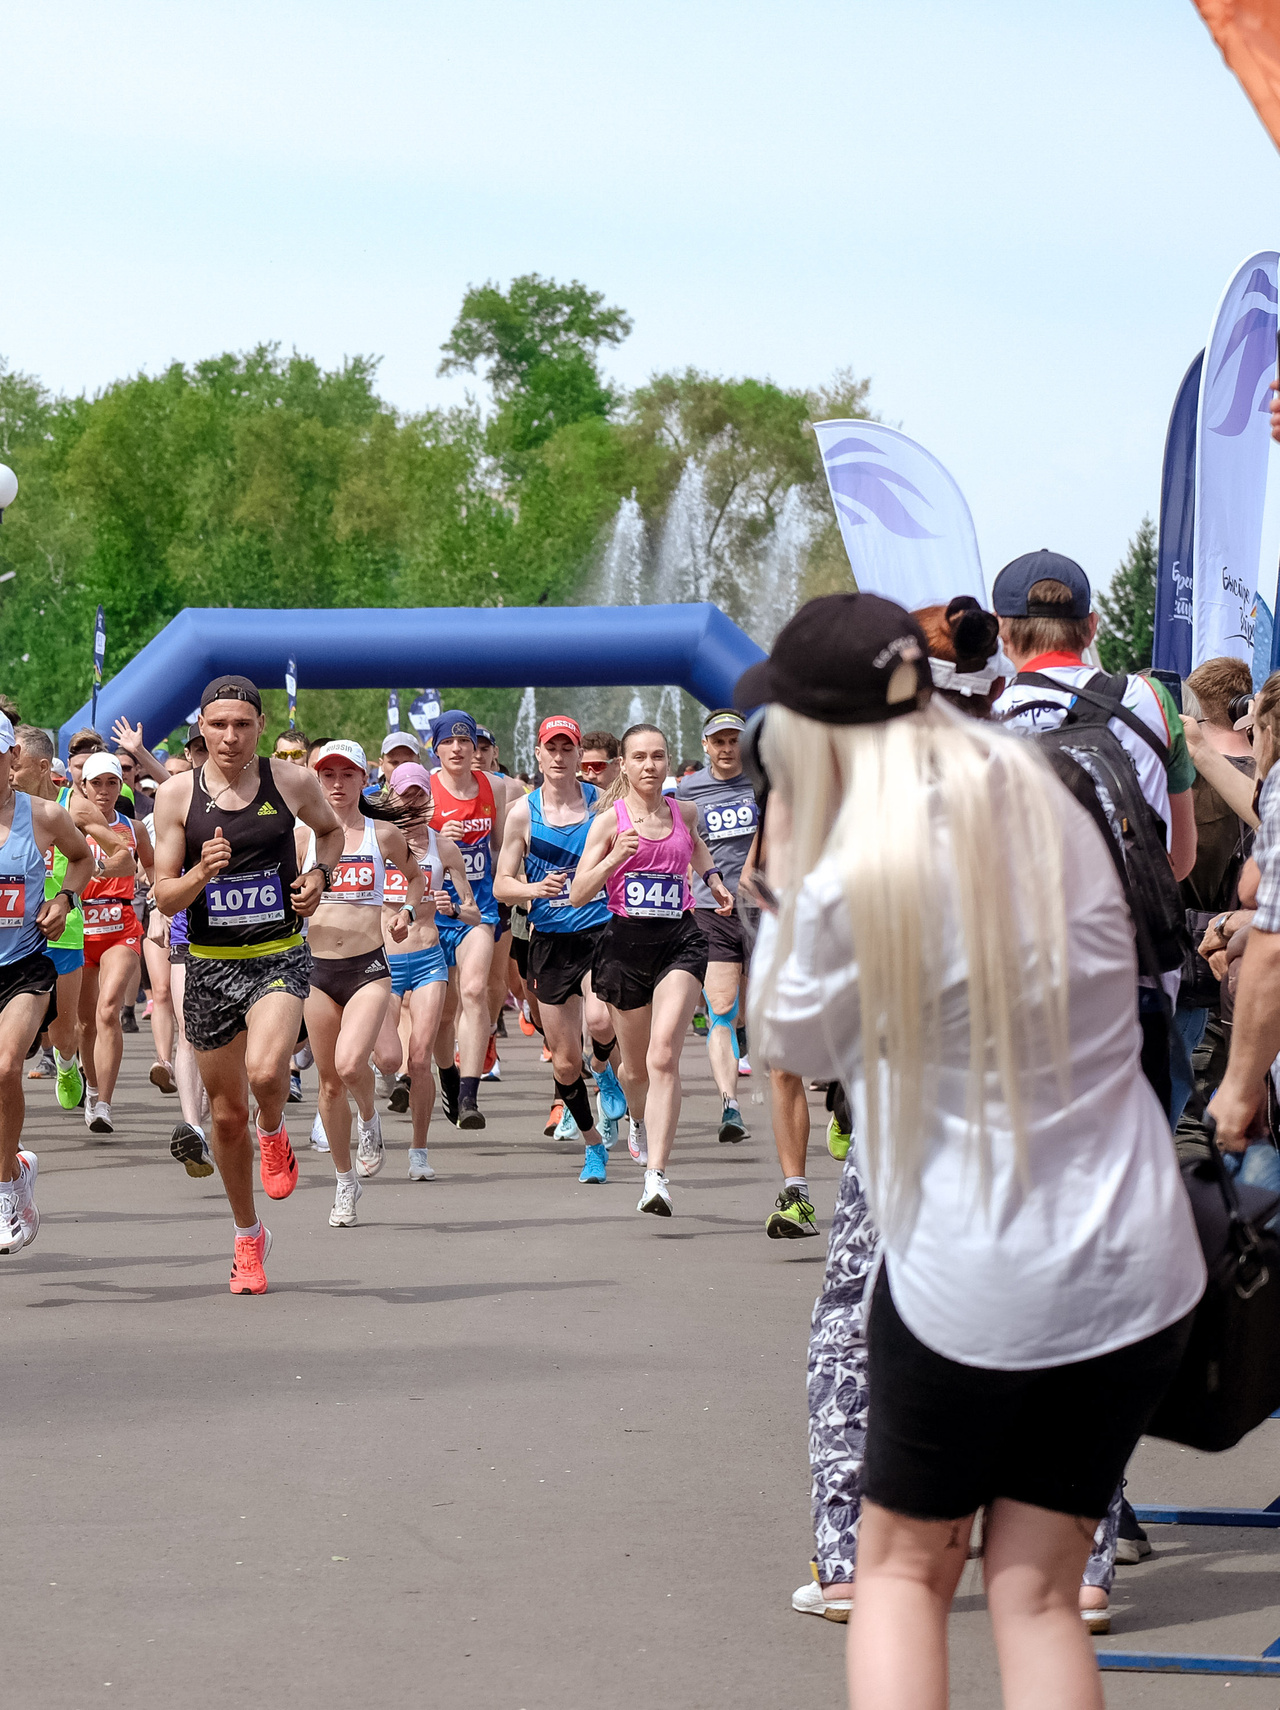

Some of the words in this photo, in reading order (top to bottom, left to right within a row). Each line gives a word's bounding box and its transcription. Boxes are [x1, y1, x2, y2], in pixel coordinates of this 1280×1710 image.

[545, 719, 576, 732] RUSSIA
[326, 743, 353, 753] RUSSIA
[461, 817, 492, 833] SSIA
[706, 806, 754, 832] 999
[463, 852, 485, 873] 20
[210, 884, 277, 911] 1076
[626, 881, 681, 908] 944
